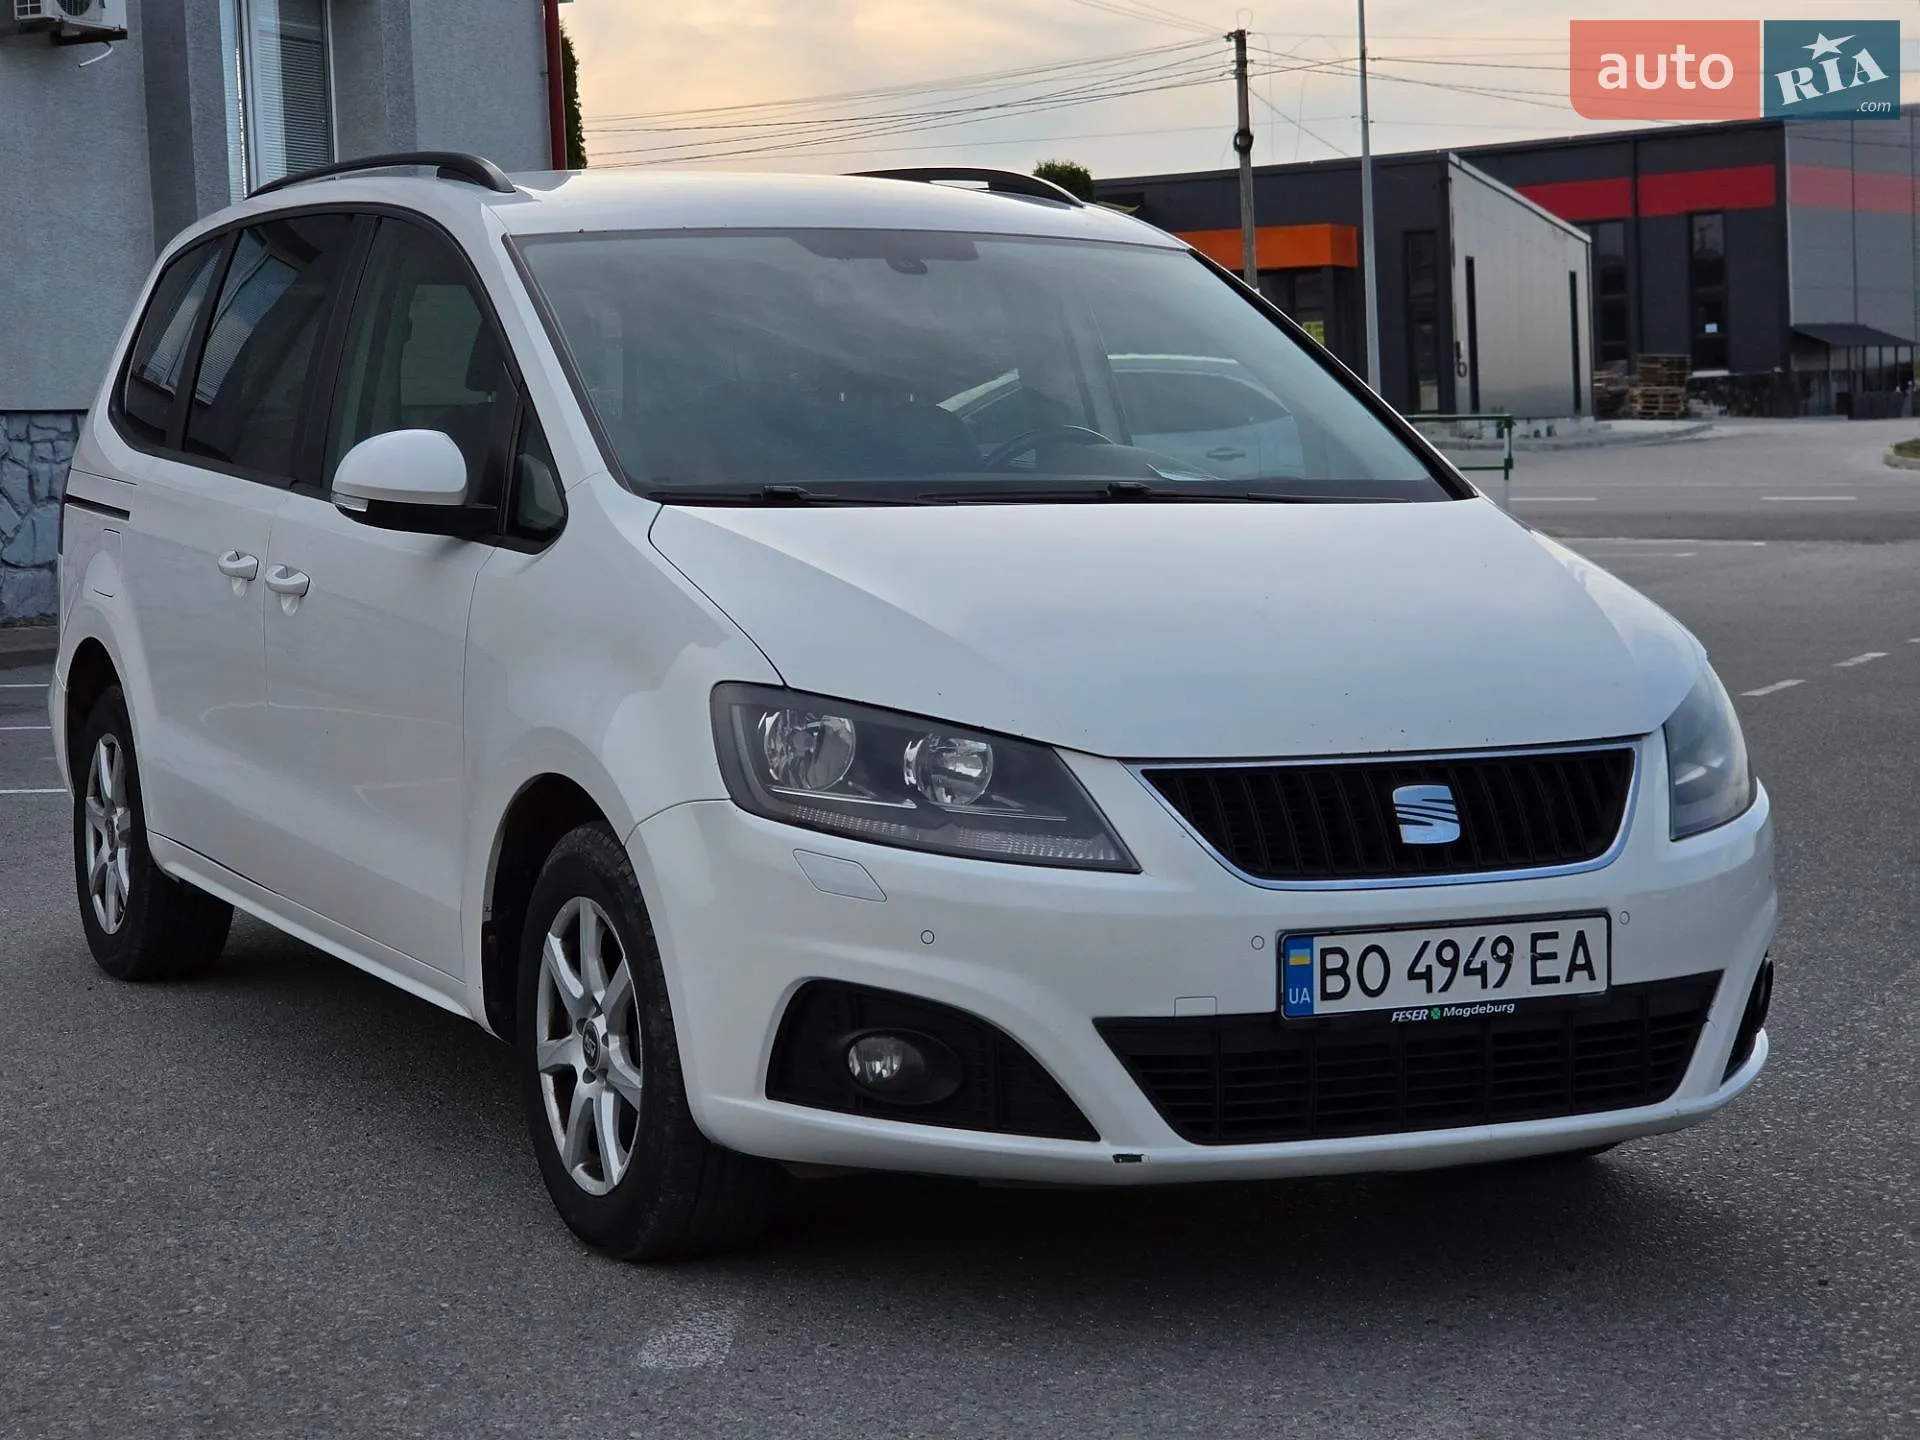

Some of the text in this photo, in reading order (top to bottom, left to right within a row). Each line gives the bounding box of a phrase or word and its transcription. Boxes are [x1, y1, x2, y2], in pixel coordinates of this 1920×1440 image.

[1318, 929, 1597, 1002] BO 4949 EA
[1288, 986, 1311, 1005] UA
[1390, 1003, 1515, 1023] FESER Magdeburg
